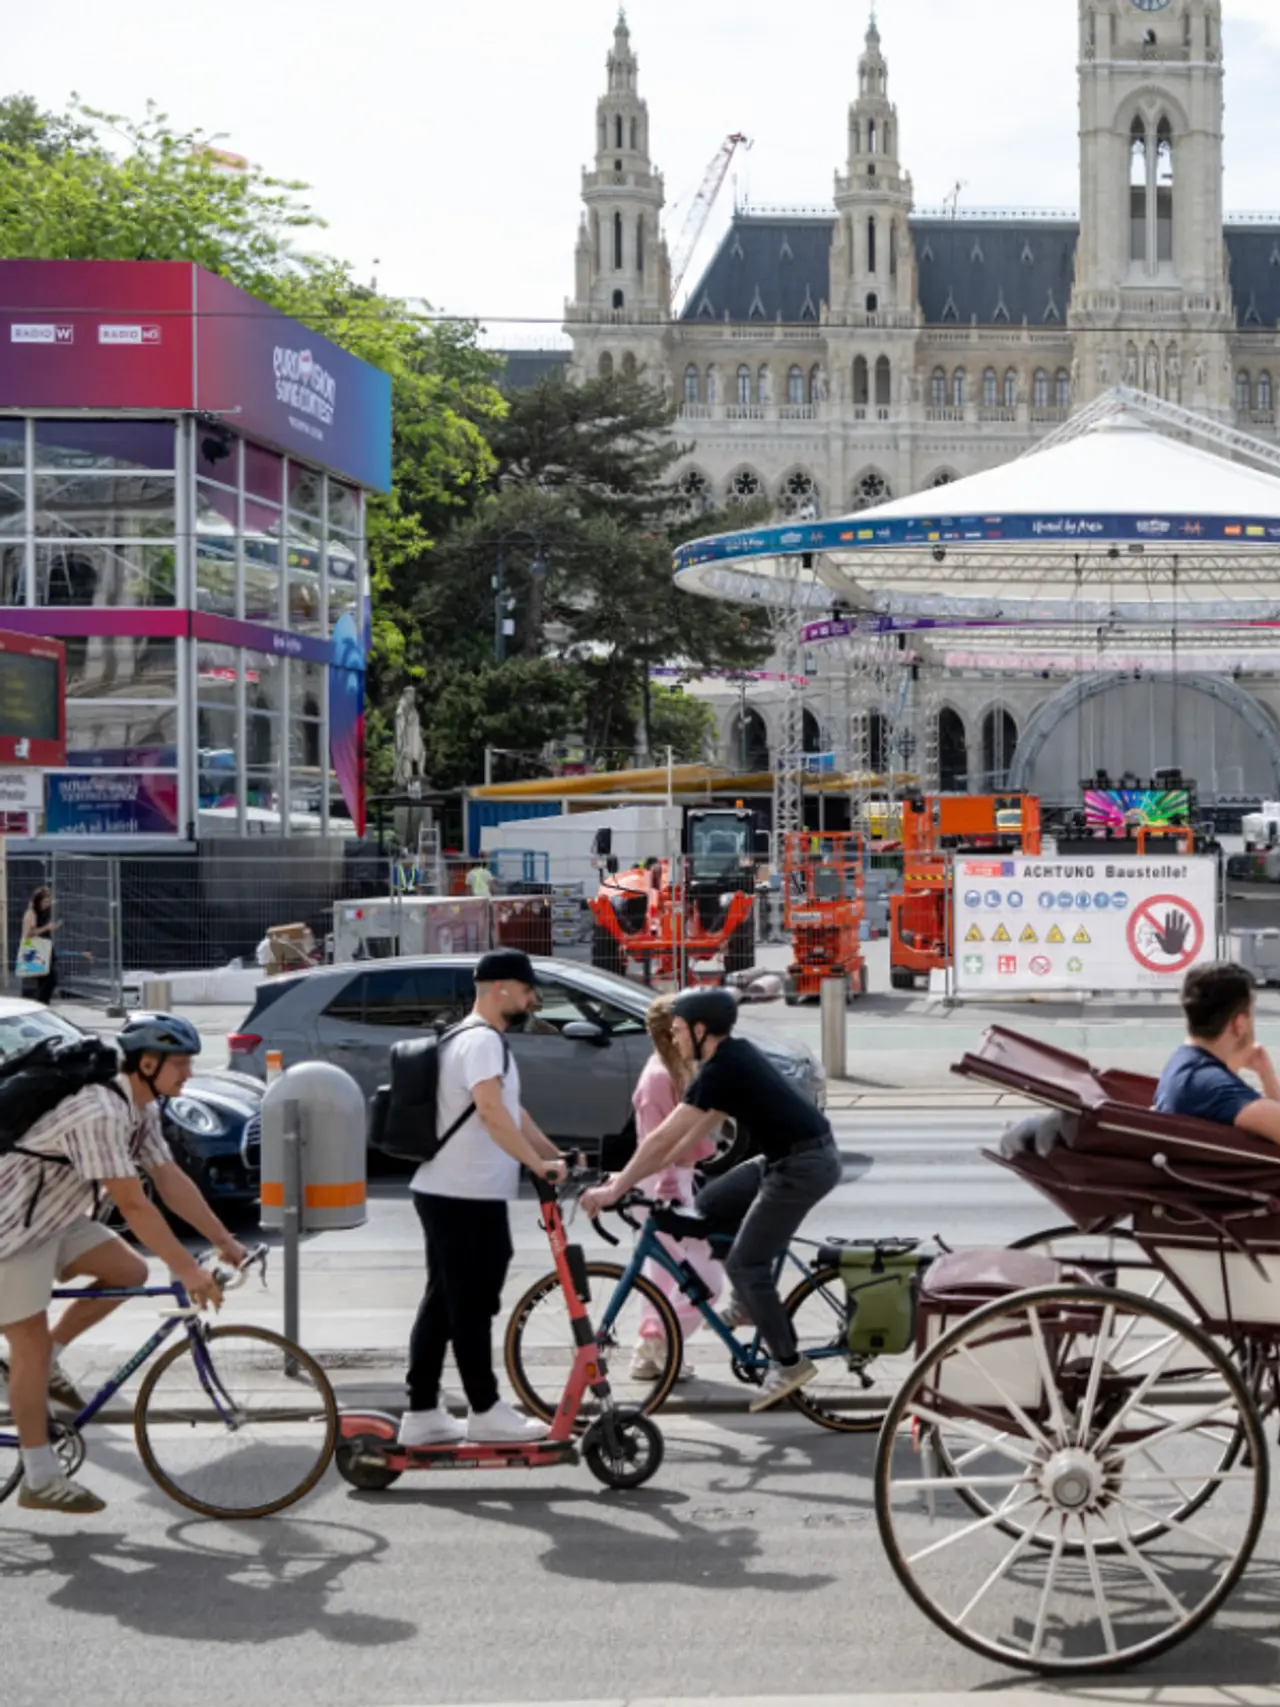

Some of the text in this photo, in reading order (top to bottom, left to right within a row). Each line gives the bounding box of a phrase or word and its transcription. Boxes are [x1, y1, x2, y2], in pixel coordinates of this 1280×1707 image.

[14, 328, 71, 339] RADIO W
[1023, 865, 1095, 878] ACHTUNG
[1105, 865, 1188, 879] Baustelle!
